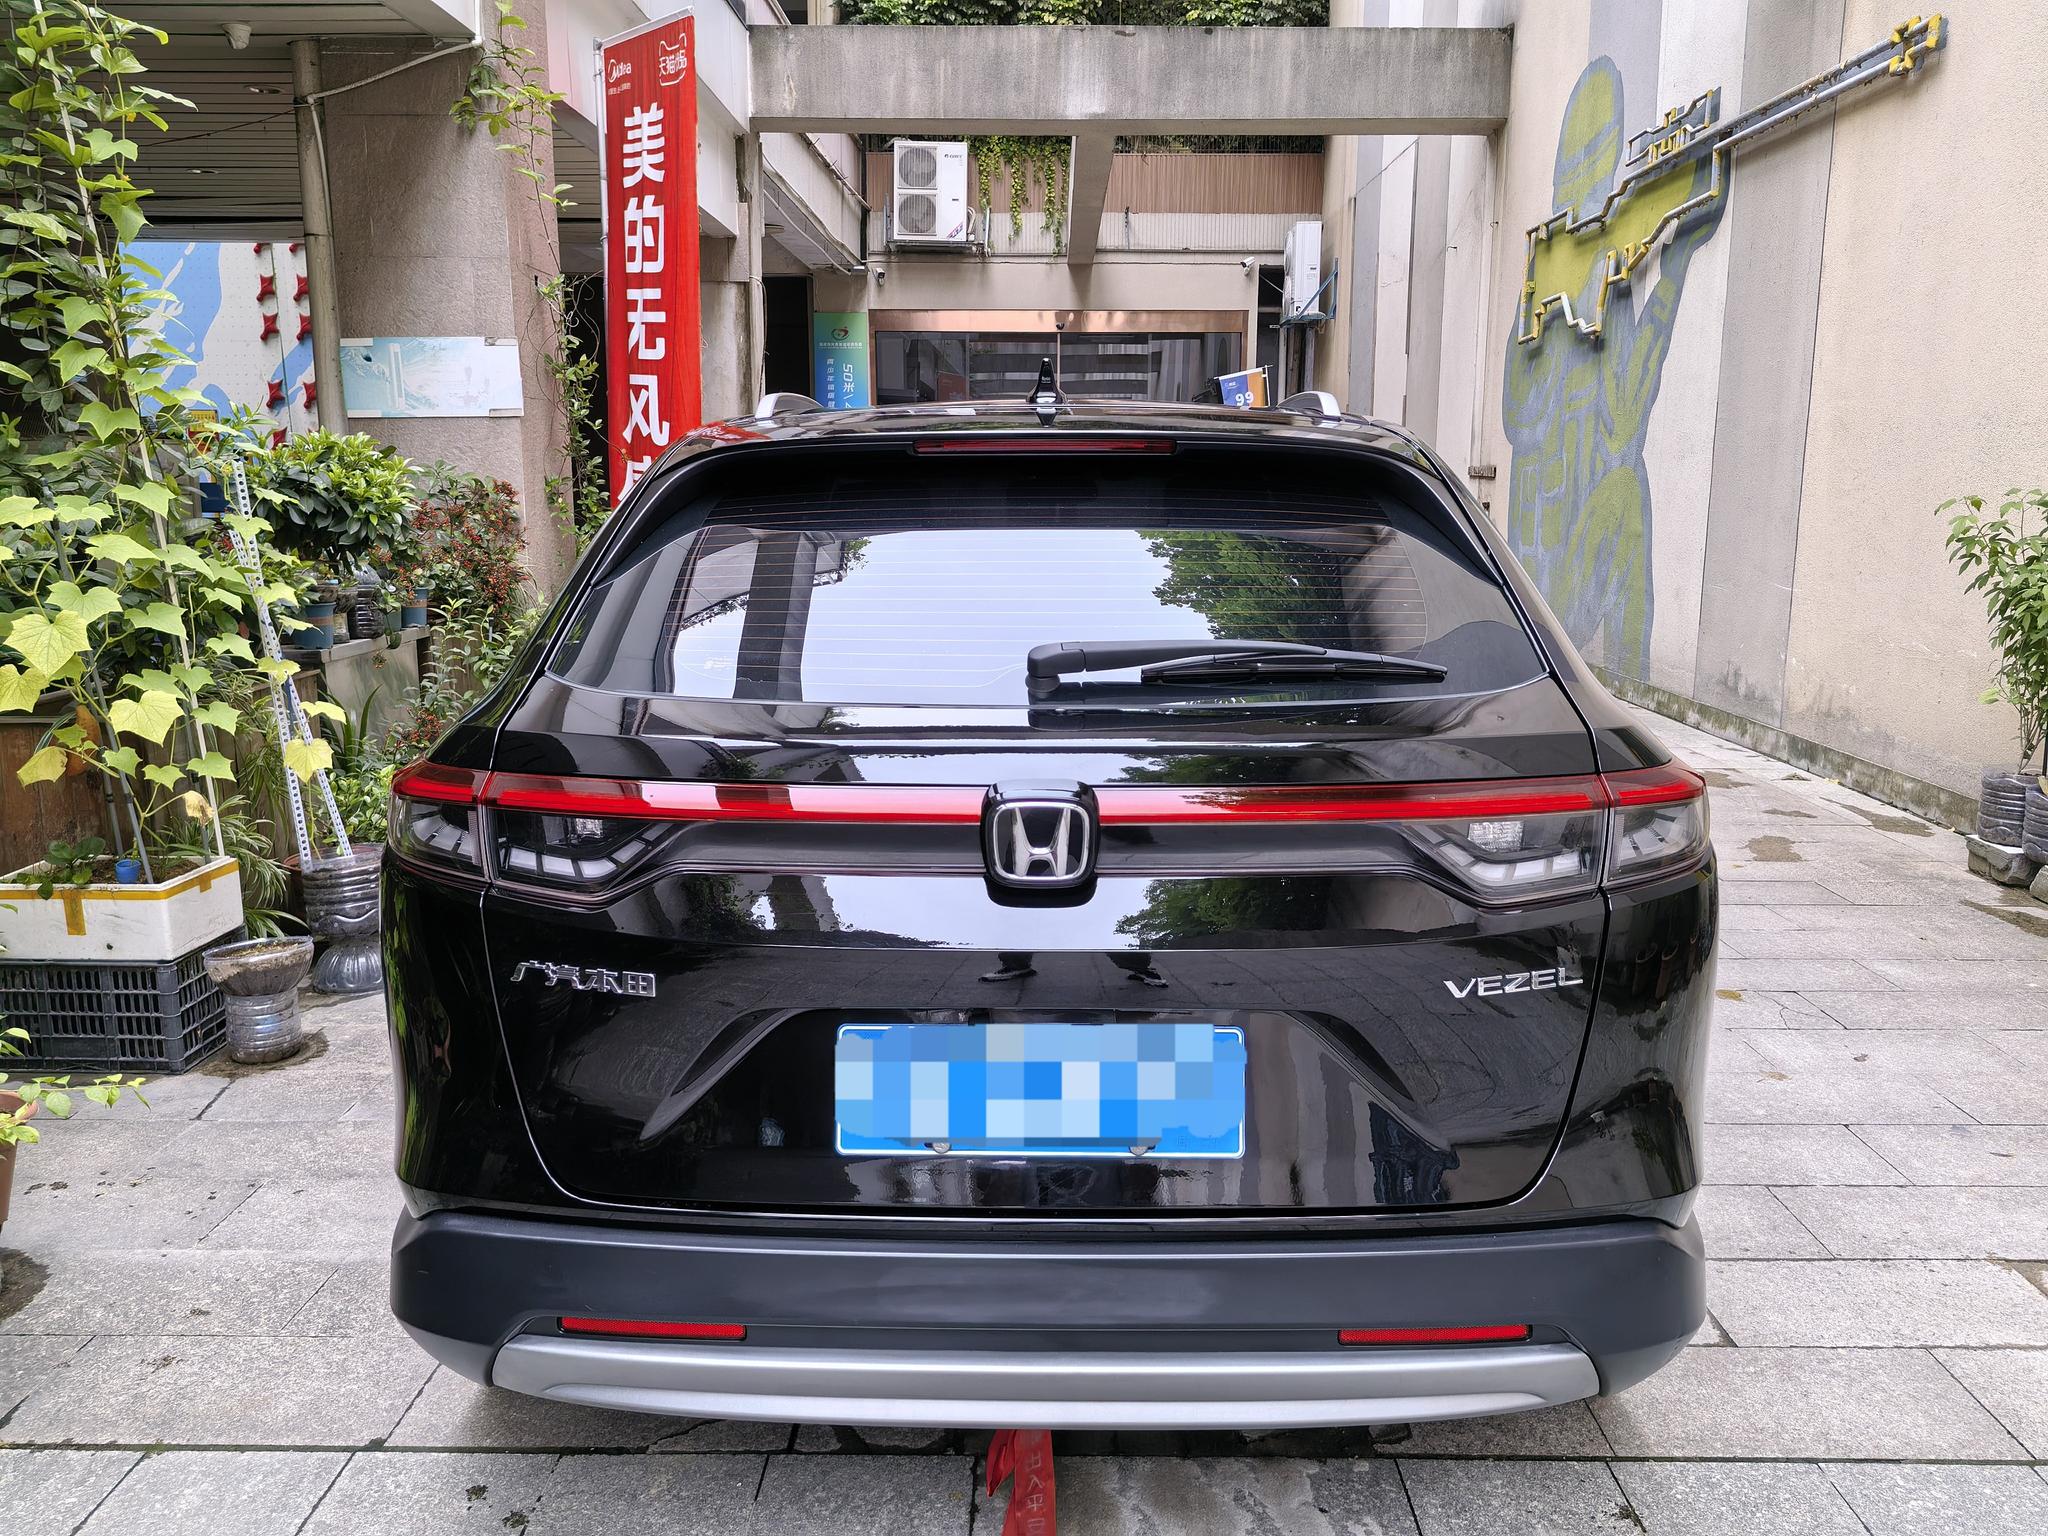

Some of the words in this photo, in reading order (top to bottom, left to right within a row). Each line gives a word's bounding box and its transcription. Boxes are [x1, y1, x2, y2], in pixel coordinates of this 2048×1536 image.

[510, 960, 656, 997] 广汽本田
[1443, 967, 1584, 998] VEZEL
